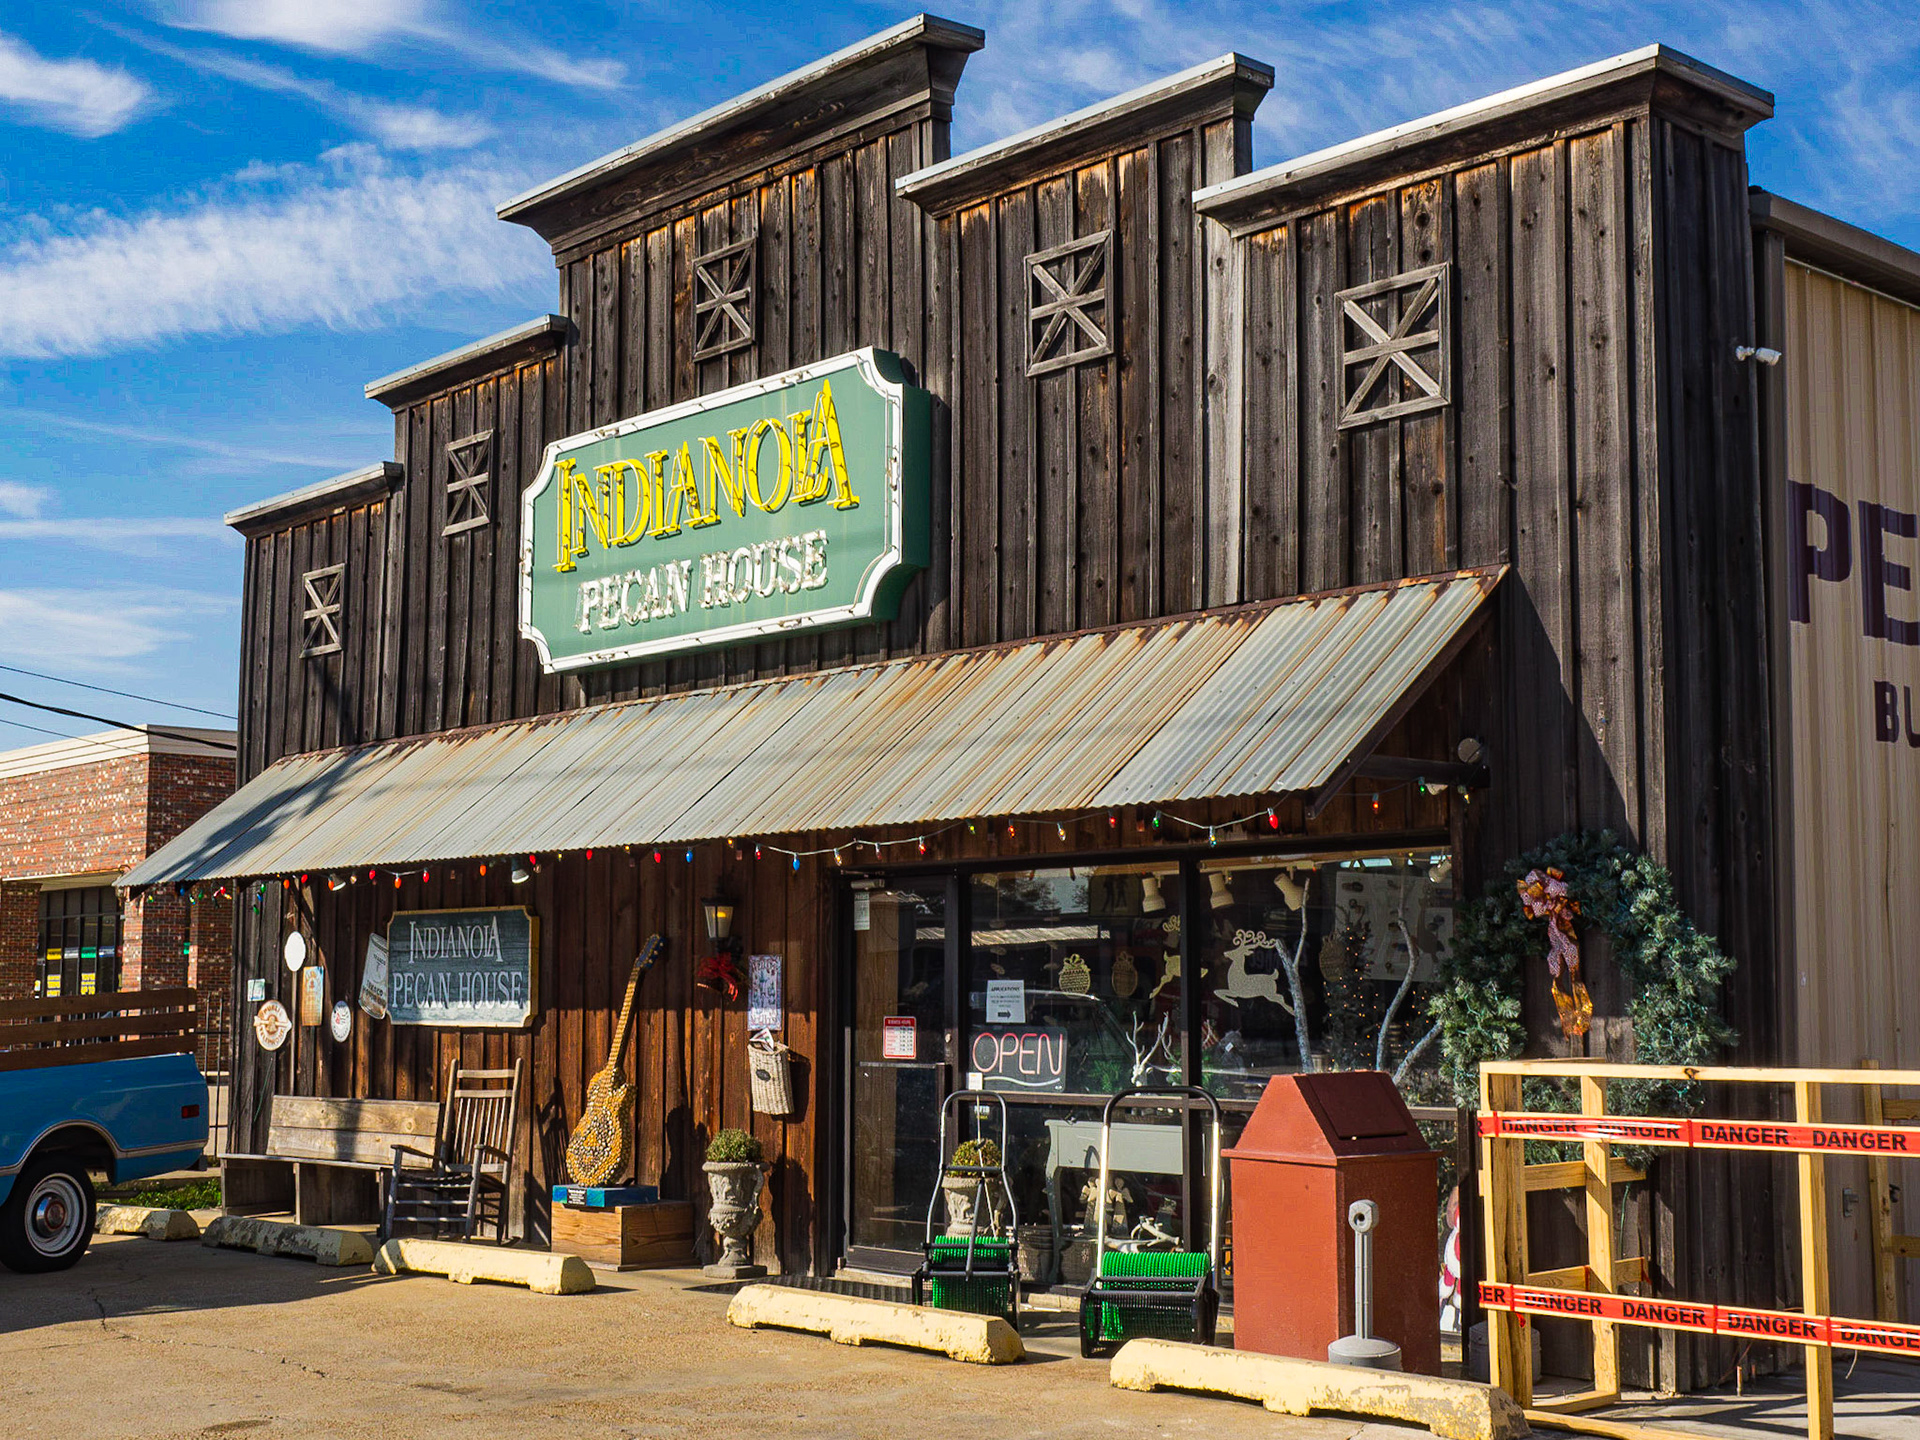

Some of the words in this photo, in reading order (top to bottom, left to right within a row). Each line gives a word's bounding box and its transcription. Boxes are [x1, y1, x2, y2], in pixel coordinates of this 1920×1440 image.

[552, 379, 860, 572] INDIANOLA
[575, 559, 692, 634] PECAN
[700, 529, 829, 608] HOUSE
[408, 915, 504, 964] INDIANOLA
[392, 972, 451, 1009] PECAN
[457, 971, 523, 1010] HOUSE
[972, 1032, 1063, 1075] OPEN
[1701, 1125, 1789, 1145] DANGER
[1813, 1130, 1907, 1150] DANGER
[1525, 1291, 1603, 1315] DANGER
[1623, 1301, 1706, 1326] DANGER
[1728, 1312, 1818, 1338] DANGER
